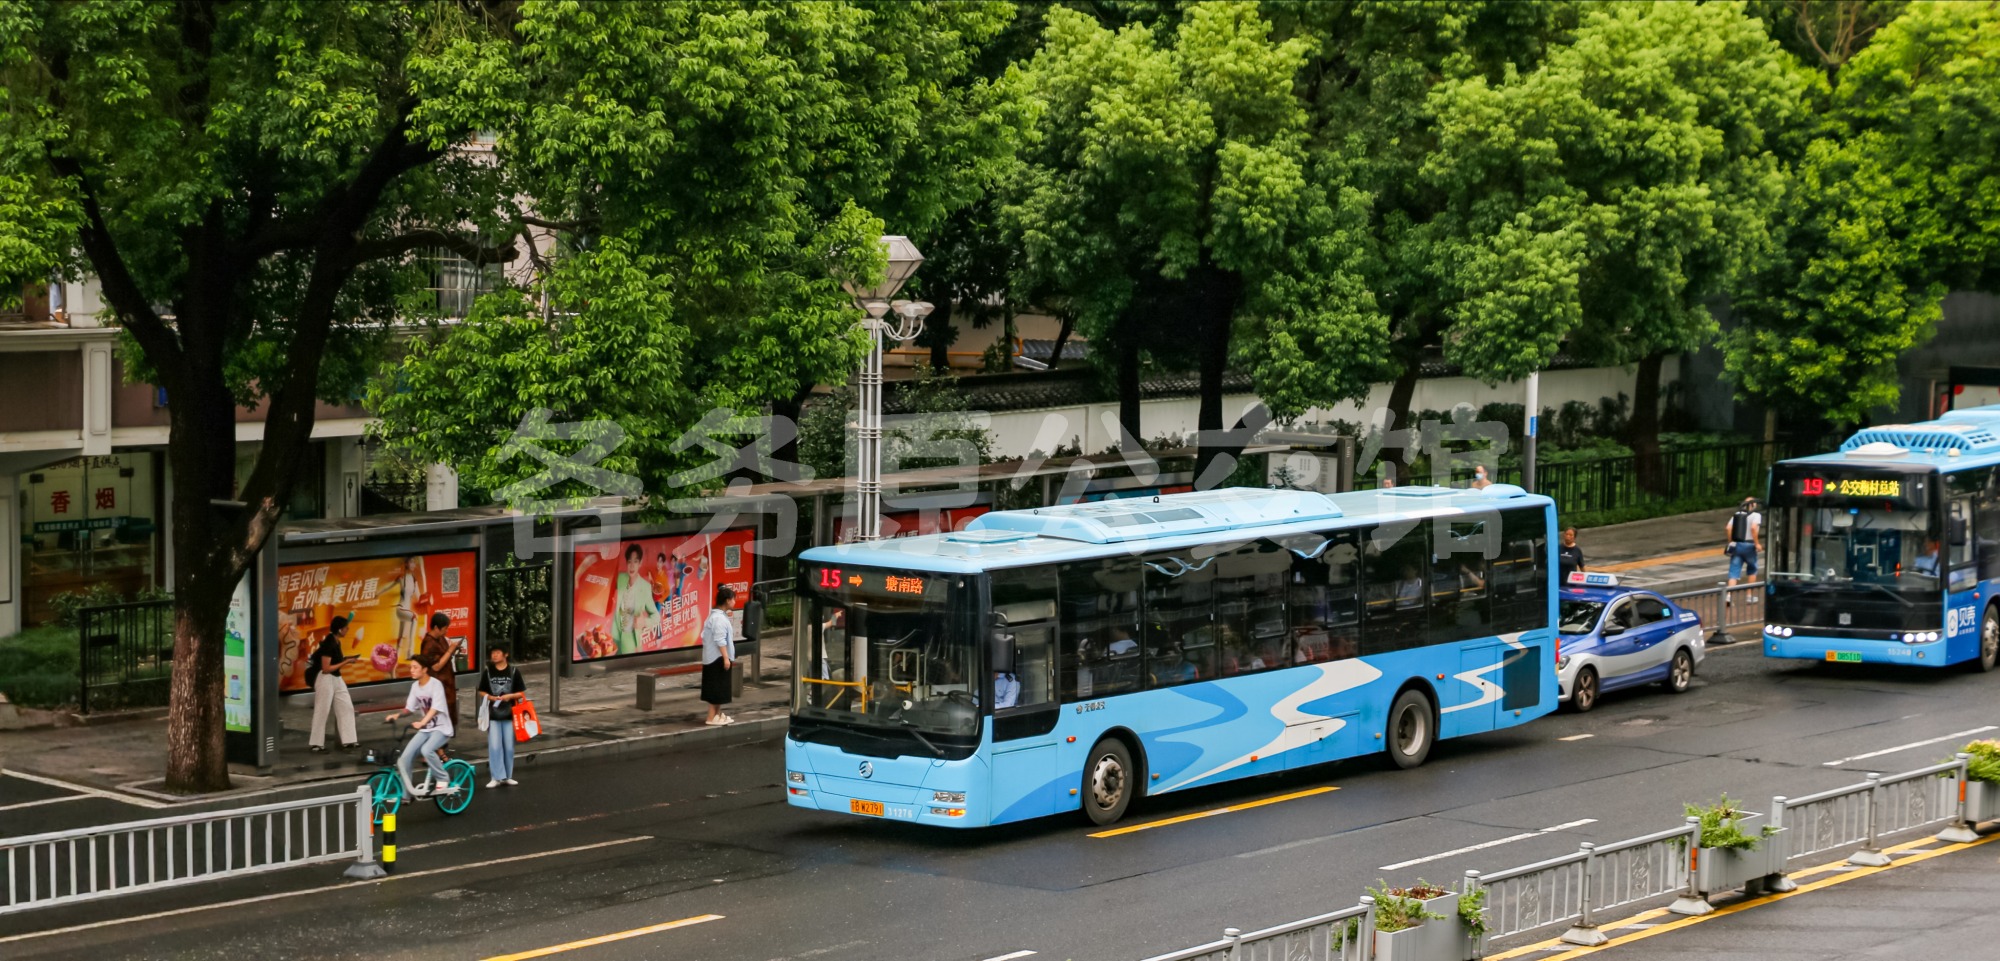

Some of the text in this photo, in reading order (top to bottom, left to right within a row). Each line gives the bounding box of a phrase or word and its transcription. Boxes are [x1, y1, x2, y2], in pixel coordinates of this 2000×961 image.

[1802, 478, 1899, 496] 19 公交梅村总站
[51, 487, 115, 514] 香烟
[278, 566, 329, 592] 淘宝闪购
[821, 569, 923, 594] 15 塘南路
[292, 577, 379, 610] 点外卖更优惠
[662, 590, 698, 617] 淘宝闪购
[641, 604, 698, 643] 点外卖更优惠
[1959, 606, 1976, 627] 贝壳
